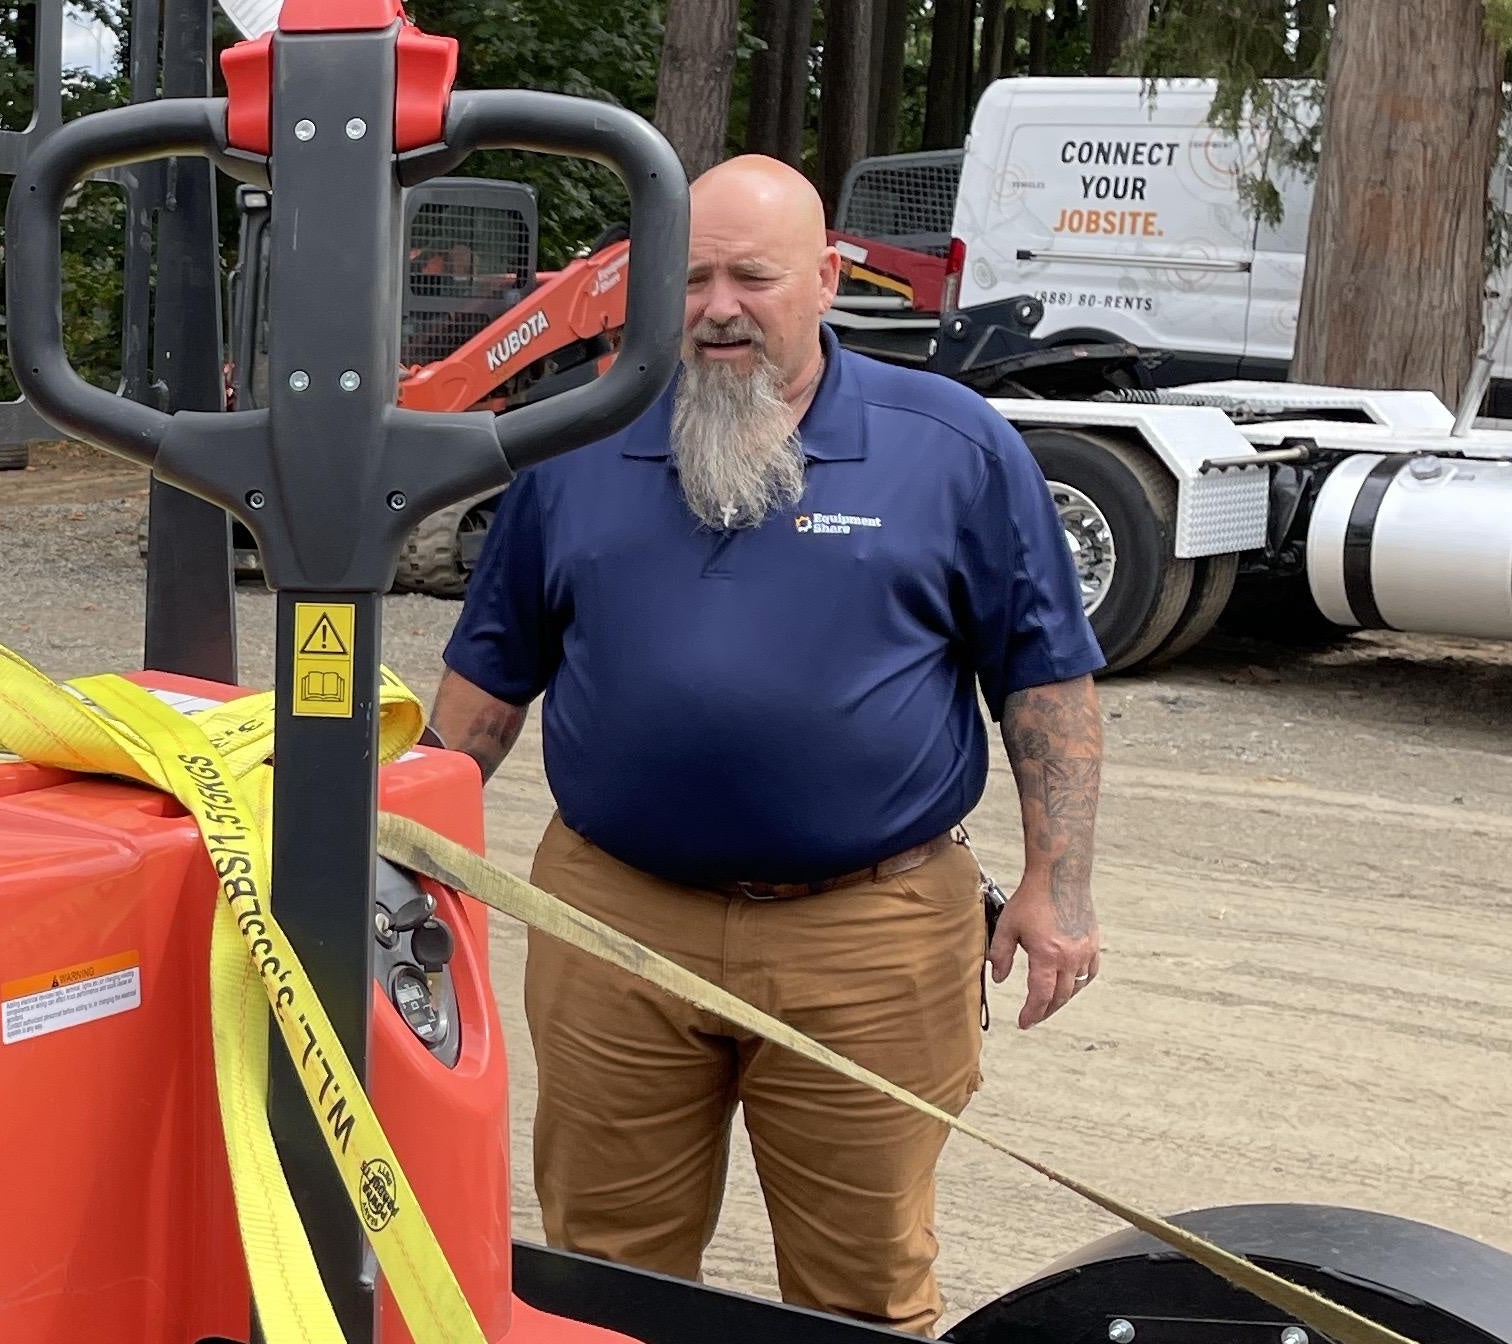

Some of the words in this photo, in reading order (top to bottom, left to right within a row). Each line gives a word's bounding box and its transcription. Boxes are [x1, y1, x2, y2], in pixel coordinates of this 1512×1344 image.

[1061, 141, 1180, 166] CONNECT
[1081, 175, 1147, 200] YOUR
[1053, 209, 1164, 237] JOBSITE.
[1078, 293, 1153, 311] 80-RENTS
[486, 310, 550, 371] KUBOTA
[813, 513, 882, 527] Equipment
[813, 523, 851, 534] Share
[59, 966, 95, 984] WARNING
